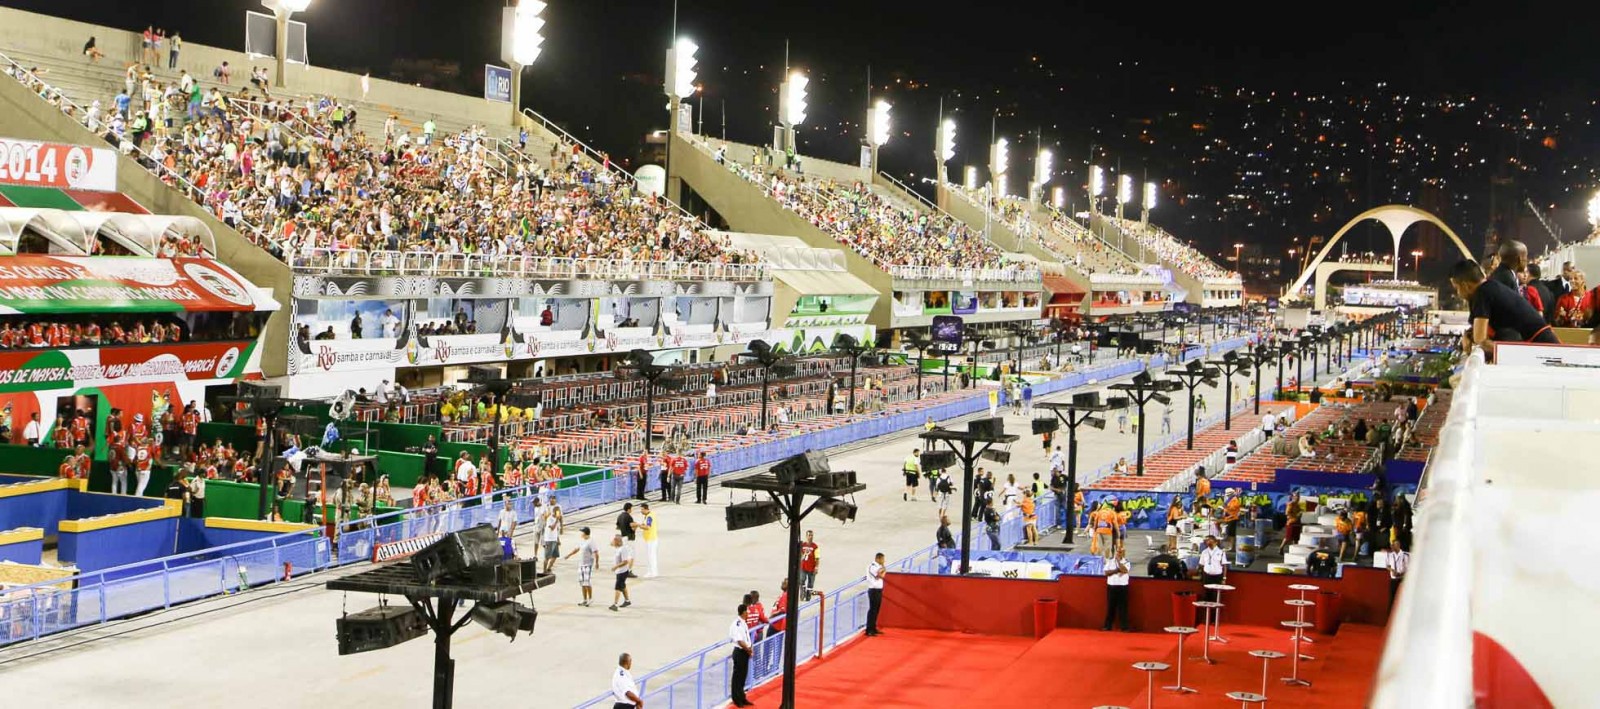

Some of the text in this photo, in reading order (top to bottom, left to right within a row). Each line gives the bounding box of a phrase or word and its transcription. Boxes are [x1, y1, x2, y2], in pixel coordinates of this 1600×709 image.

[498, 76, 510, 93] RIO
[337, 351, 359, 363] samba
[359, 353, 365, 361] e
[365, 350, 392, 362] carnaval
[451, 346, 470, 356] samba
[13, 368, 31, 384] DE
[28, 366, 65, 383] MAYSA
[104, 362, 129, 378] MAR
[184, 356, 217, 373] MARICÁ
